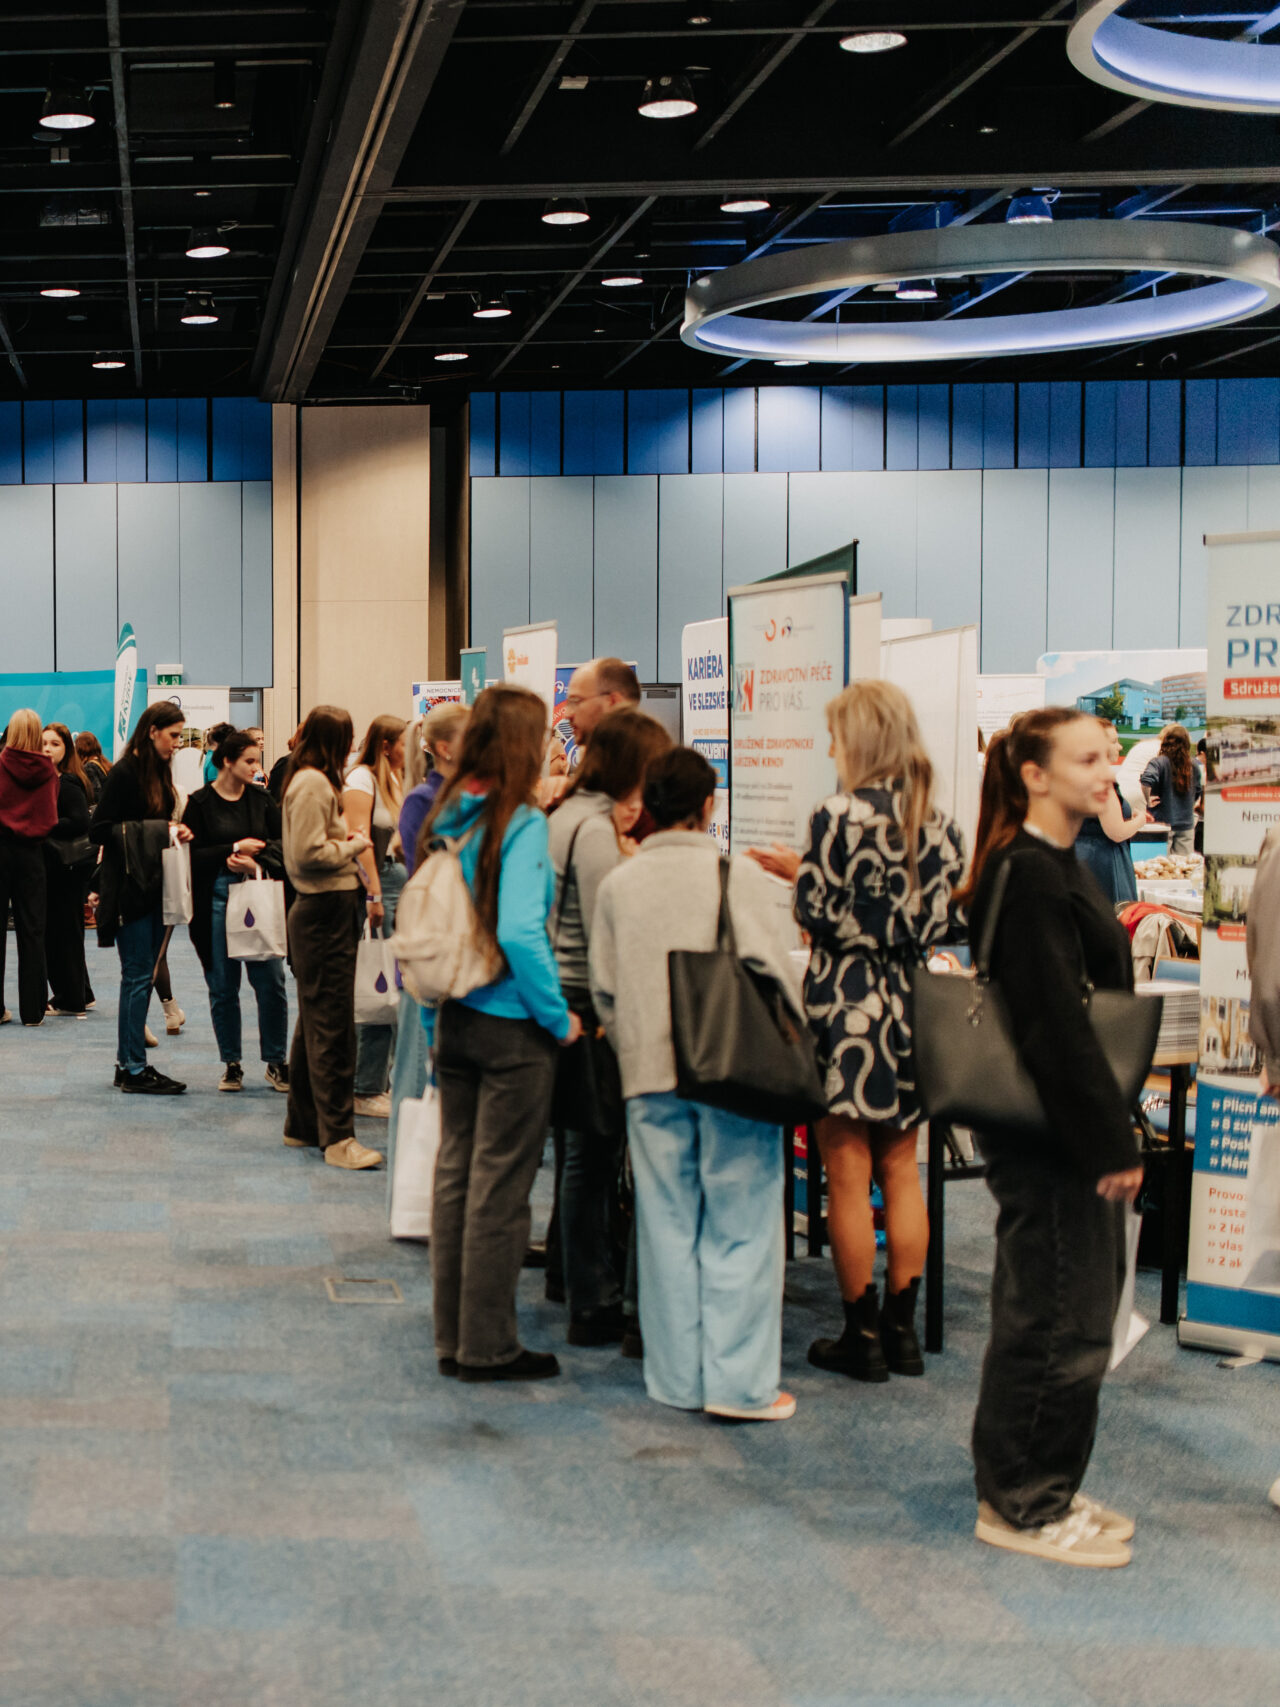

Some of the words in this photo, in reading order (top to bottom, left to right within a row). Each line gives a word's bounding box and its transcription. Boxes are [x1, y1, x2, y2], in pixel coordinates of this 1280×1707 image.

[688, 650, 724, 681] KARIÉRA
[1230, 681, 1280, 695] Sdruže
[689, 692, 697, 711] VE
[698, 686, 725, 711] SLEZSKÉ
[1223, 1096, 1257, 1115] Plicní
[1209, 1186, 1247, 1201] Provo
